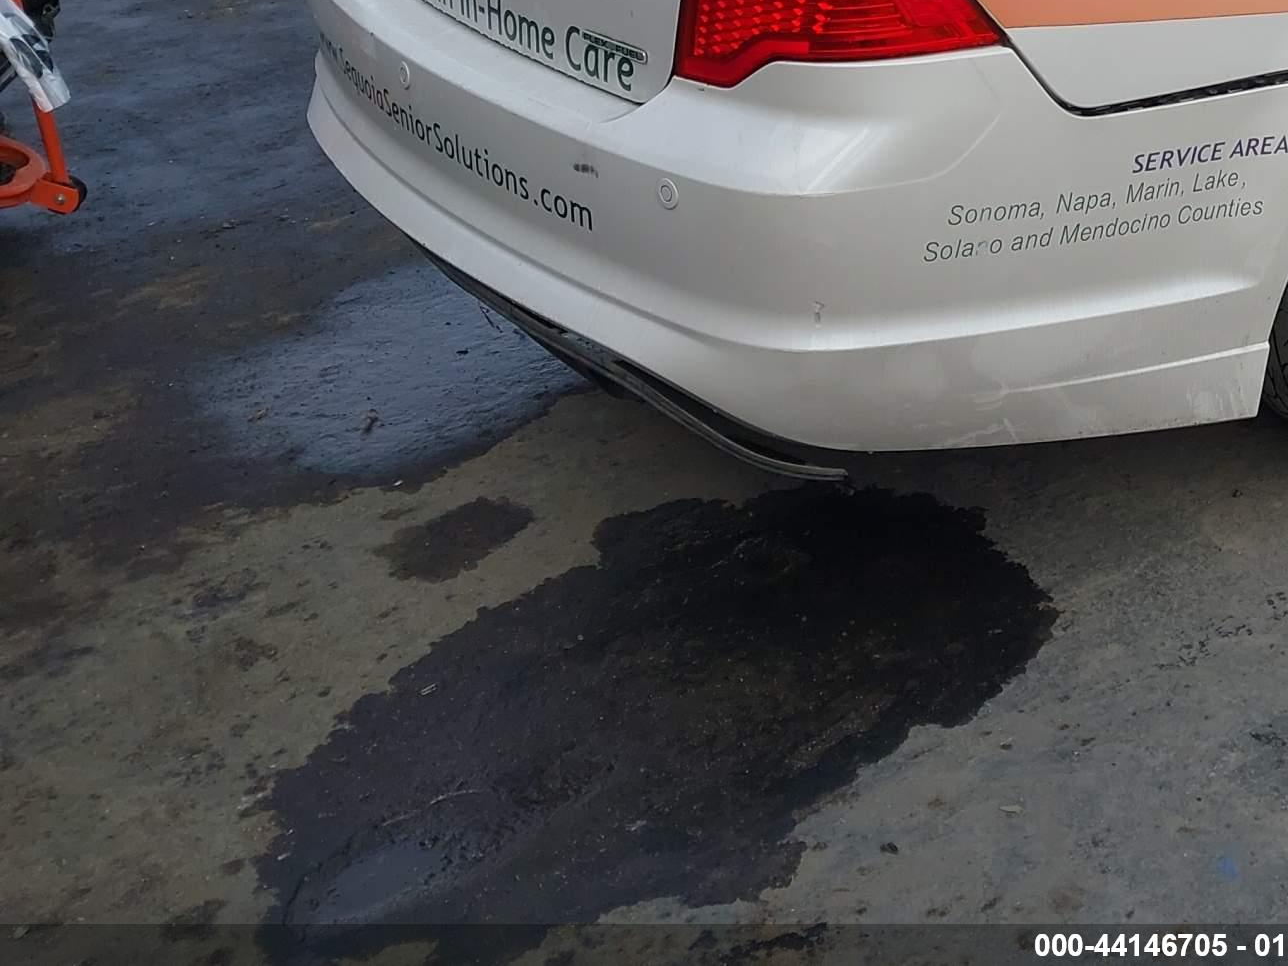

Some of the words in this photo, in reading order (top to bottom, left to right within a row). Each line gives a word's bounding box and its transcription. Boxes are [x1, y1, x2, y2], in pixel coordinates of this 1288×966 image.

[565, 26, 634, 91] Care
[583, 32, 607, 46] FLEX
[615, 44, 645, 61] FUEL
[318, 33, 593, 231] wwSequoiaSeniorSolutions.com
[1132, 141, 1225, 174] SERVICE
[948, 198, 1046, 226] Sonoma,
[1056, 190, 1116, 216] Napa,
[1193, 169, 1246, 193] Lake,
[1011, 227, 1052, 252] and
[1059, 207, 1171, 246] Mendocino
[1178, 198, 1263, 225] Counties
